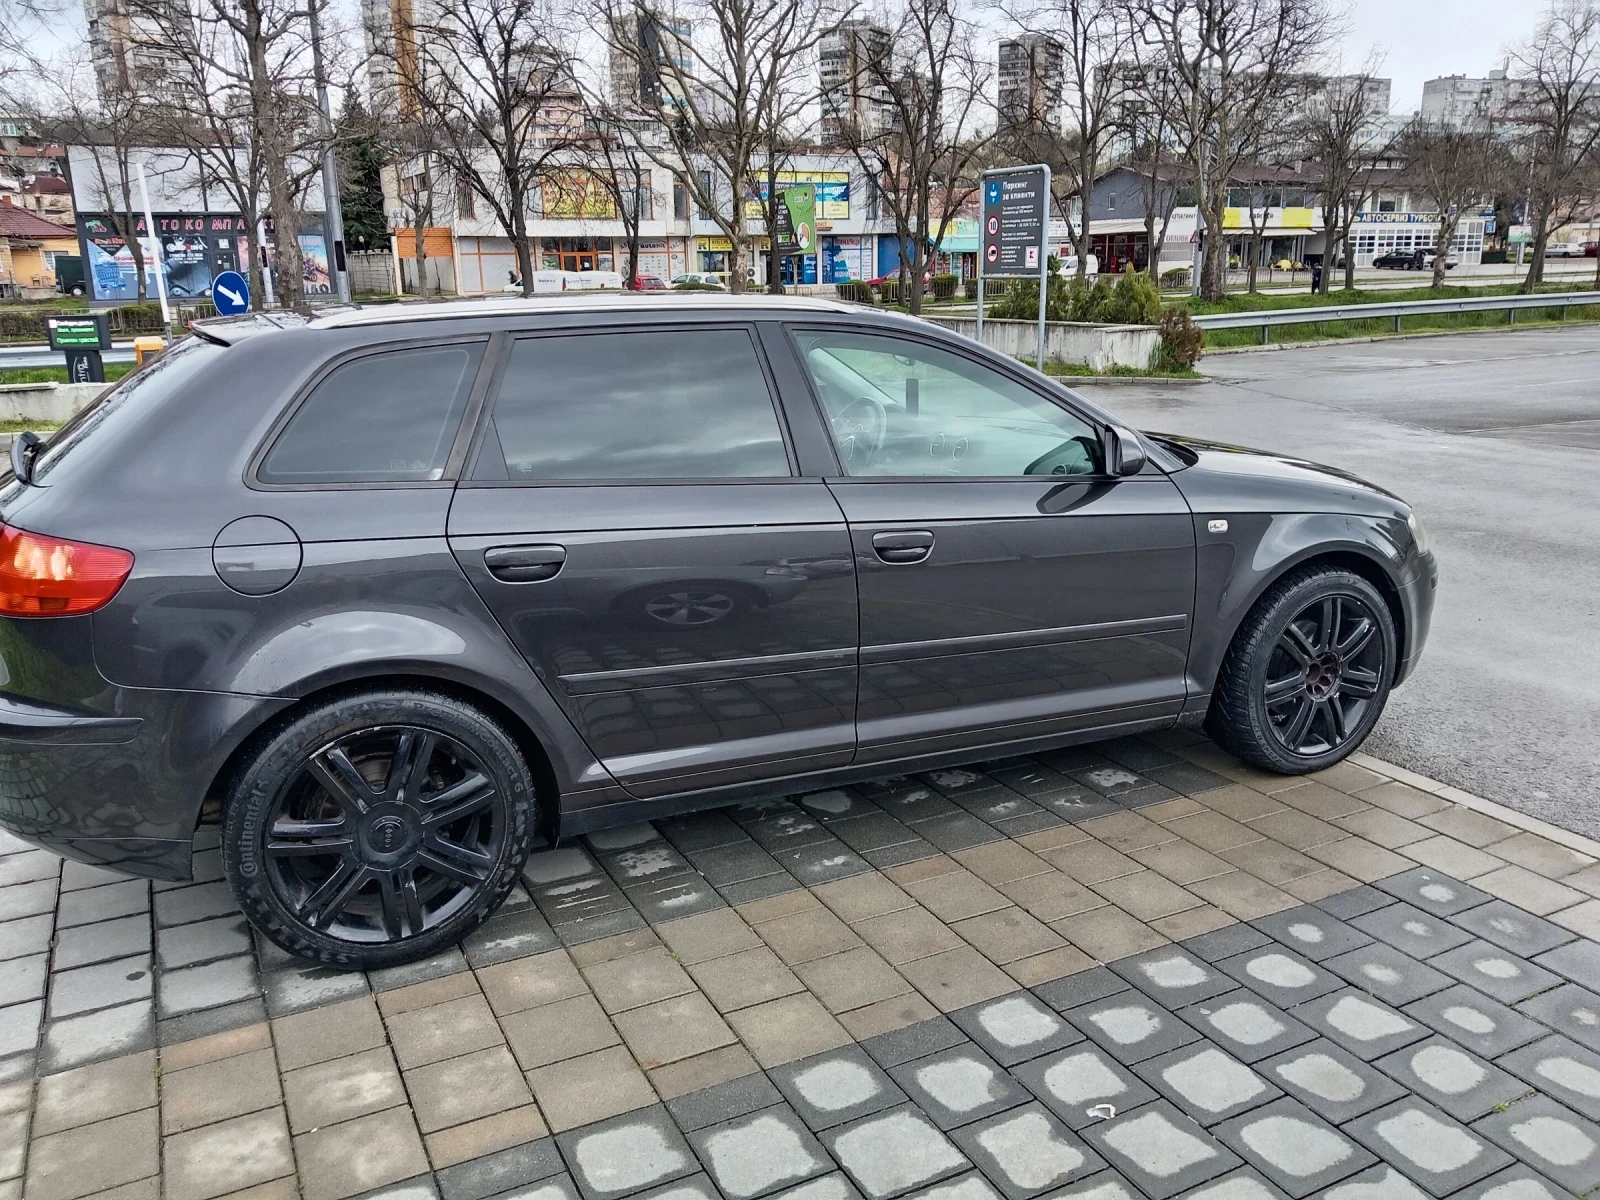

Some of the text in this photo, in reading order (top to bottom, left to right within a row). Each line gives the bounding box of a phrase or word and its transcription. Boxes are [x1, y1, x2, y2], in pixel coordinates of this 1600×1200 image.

[1003, 181, 1028, 191] Паркинг
[1010, 191, 1035, 199] клиенти
[1362, 213, 1409, 222] АВТОСЕРВИЗ
[990, 221, 996, 231] 10
[238, 788, 266, 878] Continental
